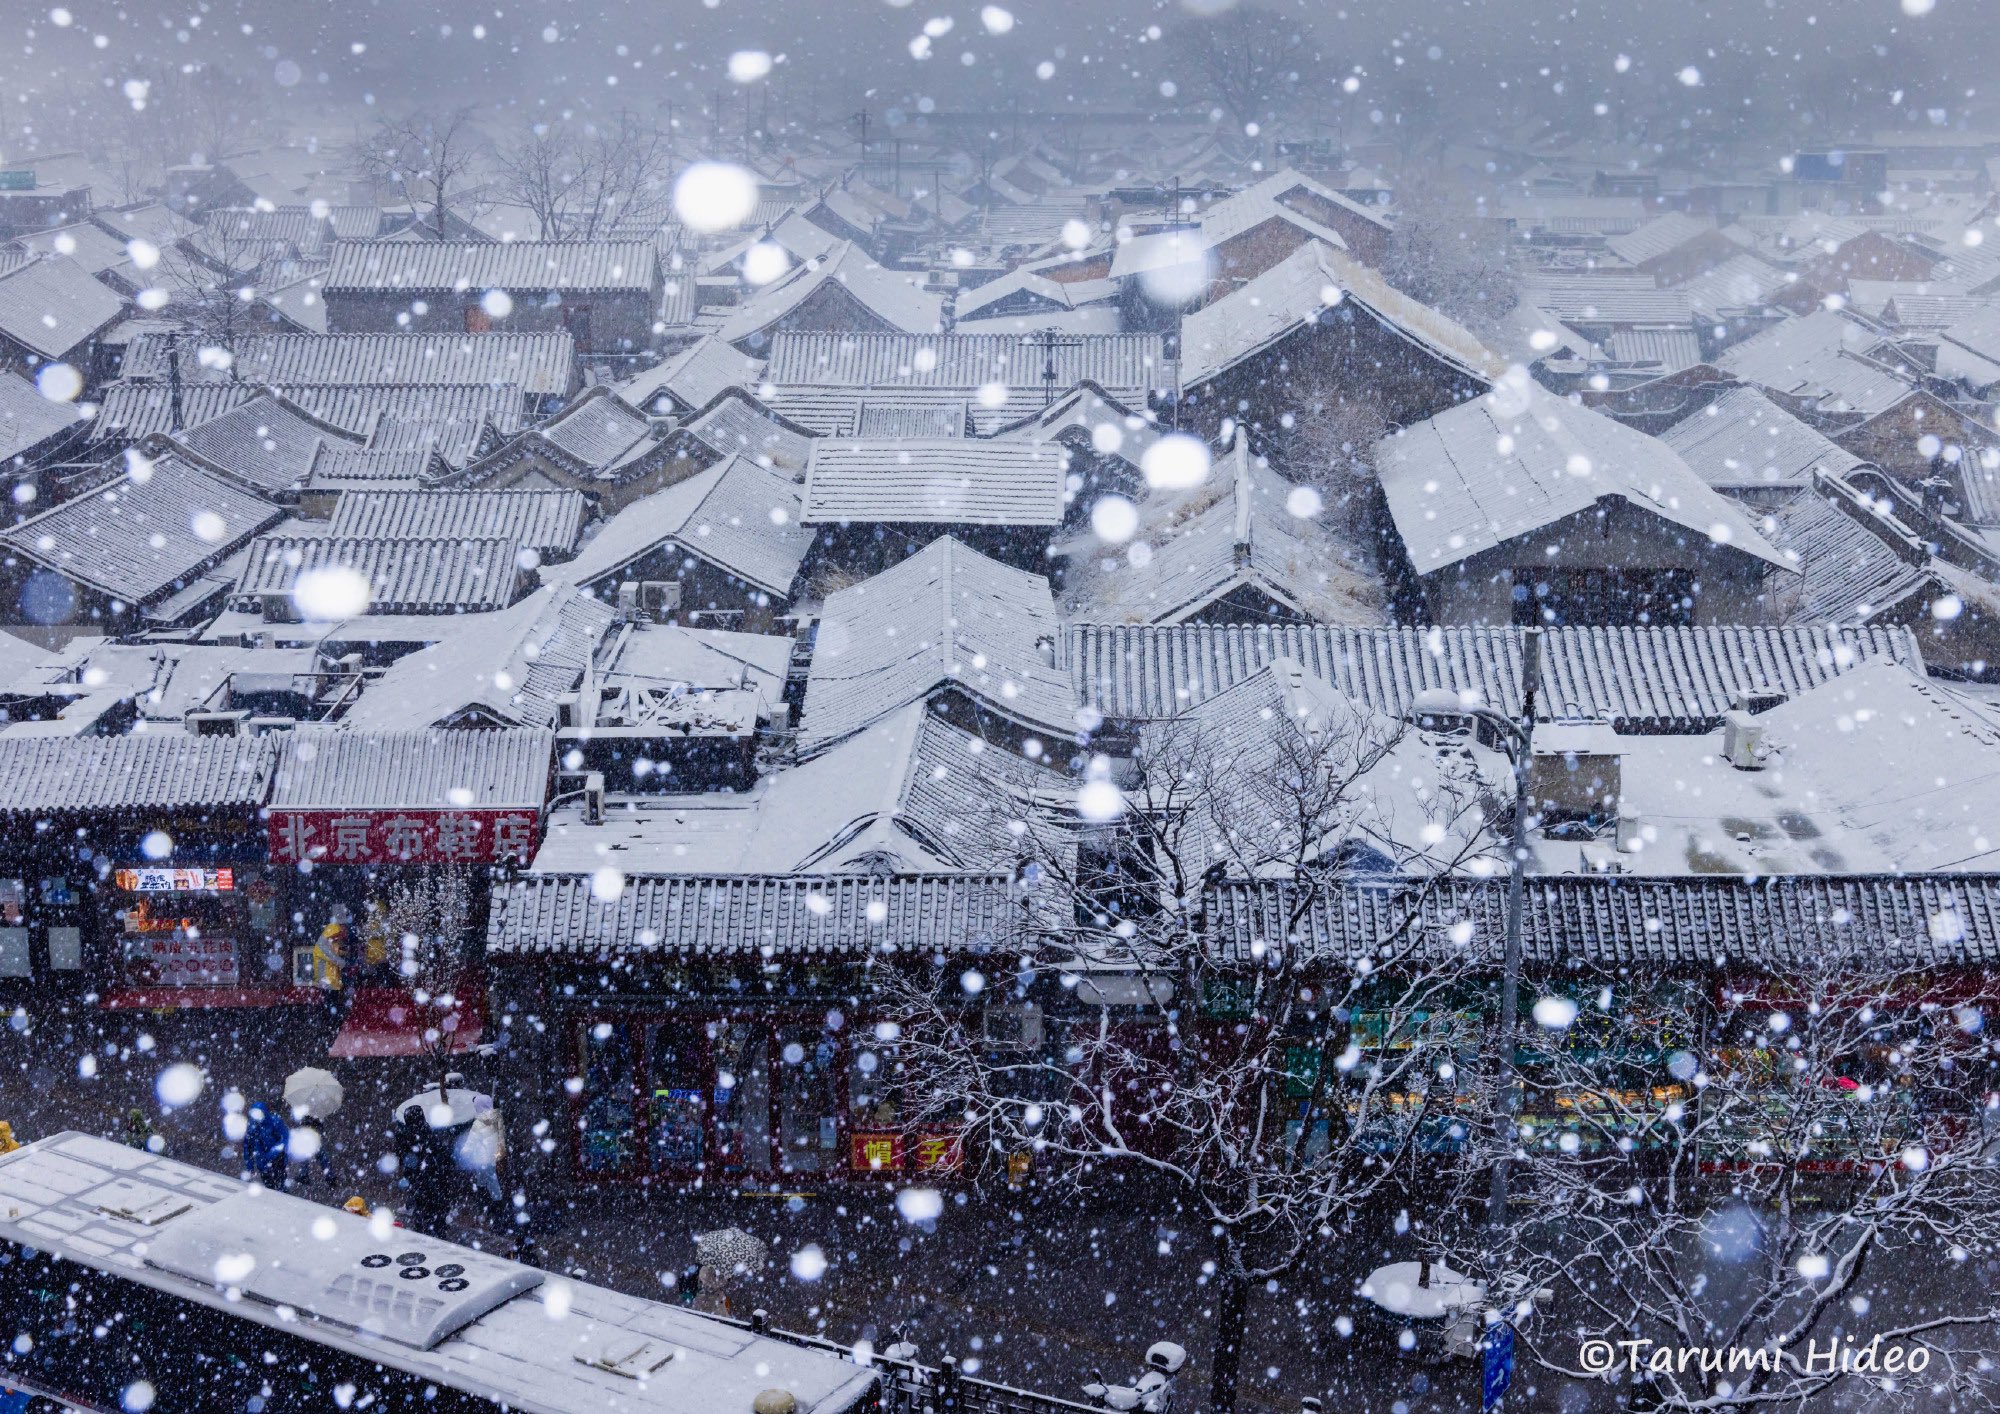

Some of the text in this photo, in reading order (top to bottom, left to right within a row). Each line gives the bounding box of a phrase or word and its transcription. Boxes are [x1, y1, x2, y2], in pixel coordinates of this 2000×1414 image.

[278, 814, 531, 859] 北京布鞋店
[865, 1141, 946, 1164] 帽子
